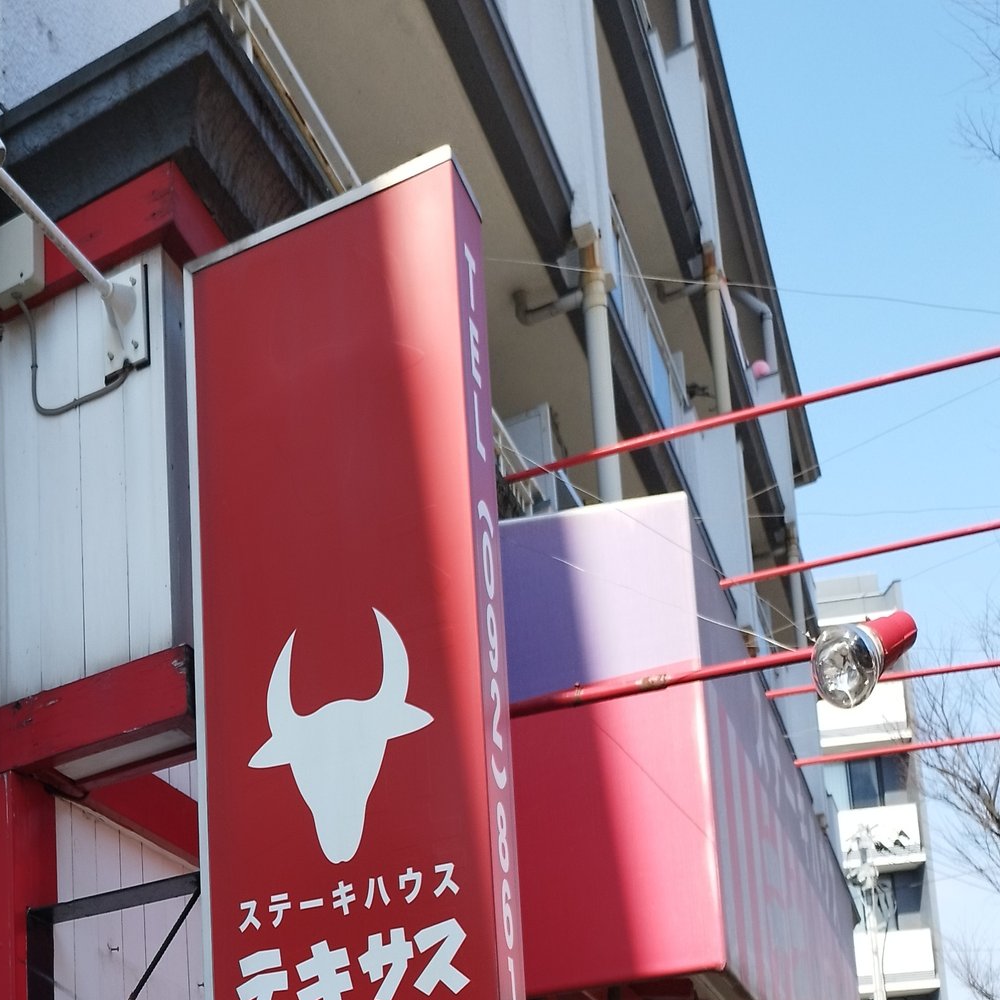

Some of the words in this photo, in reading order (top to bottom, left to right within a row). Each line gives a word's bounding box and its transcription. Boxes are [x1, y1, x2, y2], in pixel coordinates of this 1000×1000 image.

[464, 242, 486, 462] TEL
[239, 862, 460, 933] ステーキハウス
